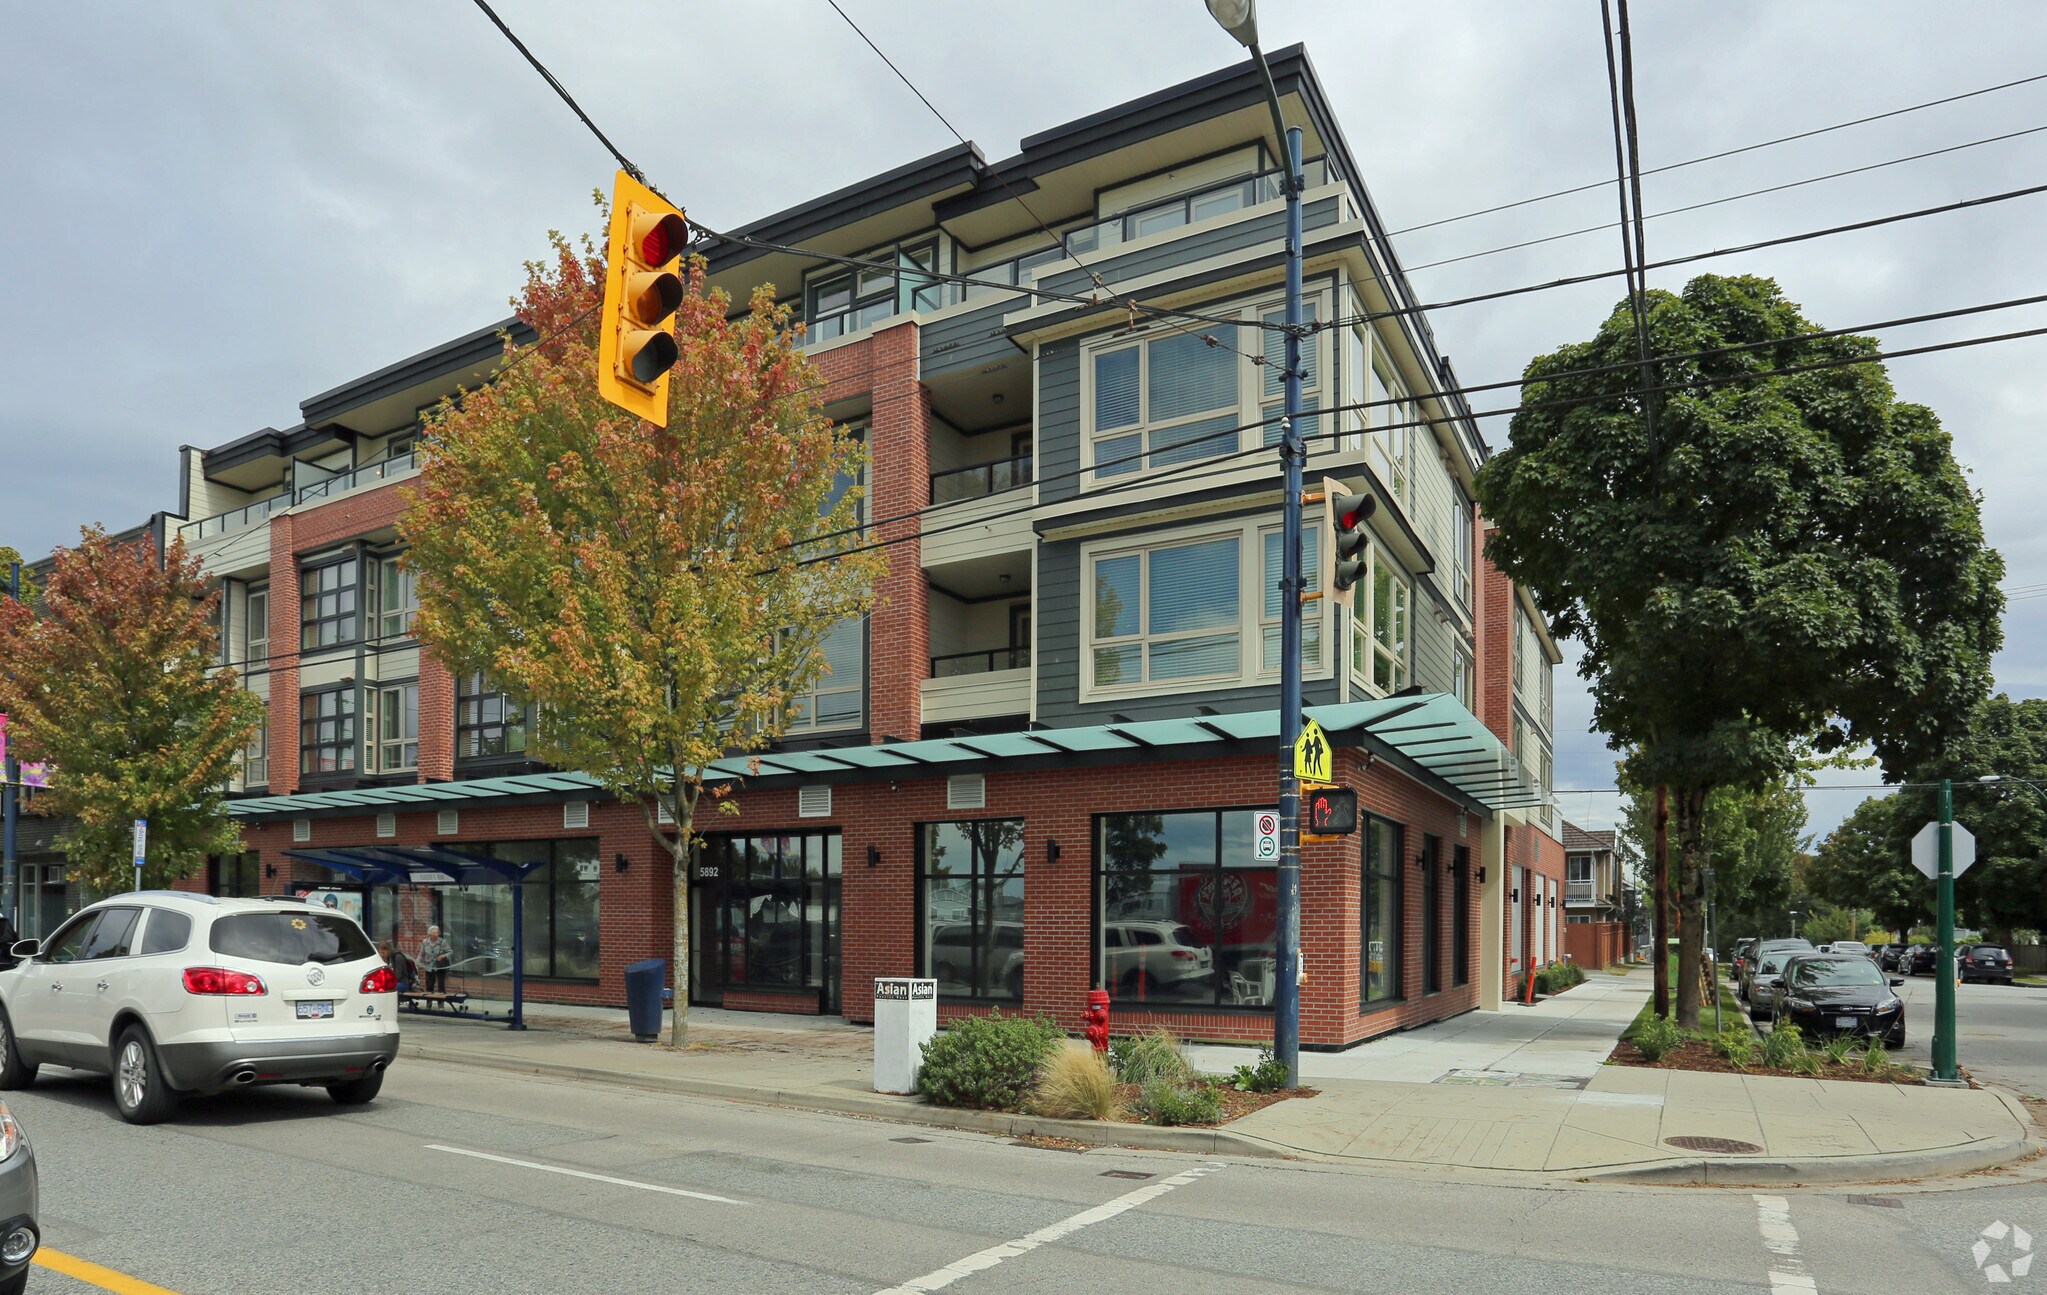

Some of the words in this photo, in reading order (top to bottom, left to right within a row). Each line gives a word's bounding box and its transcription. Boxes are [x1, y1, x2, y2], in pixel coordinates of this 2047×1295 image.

[700, 866, 719, 877] 5892
[876, 982, 907, 996] Asian
[912, 982, 933, 996] Asian
